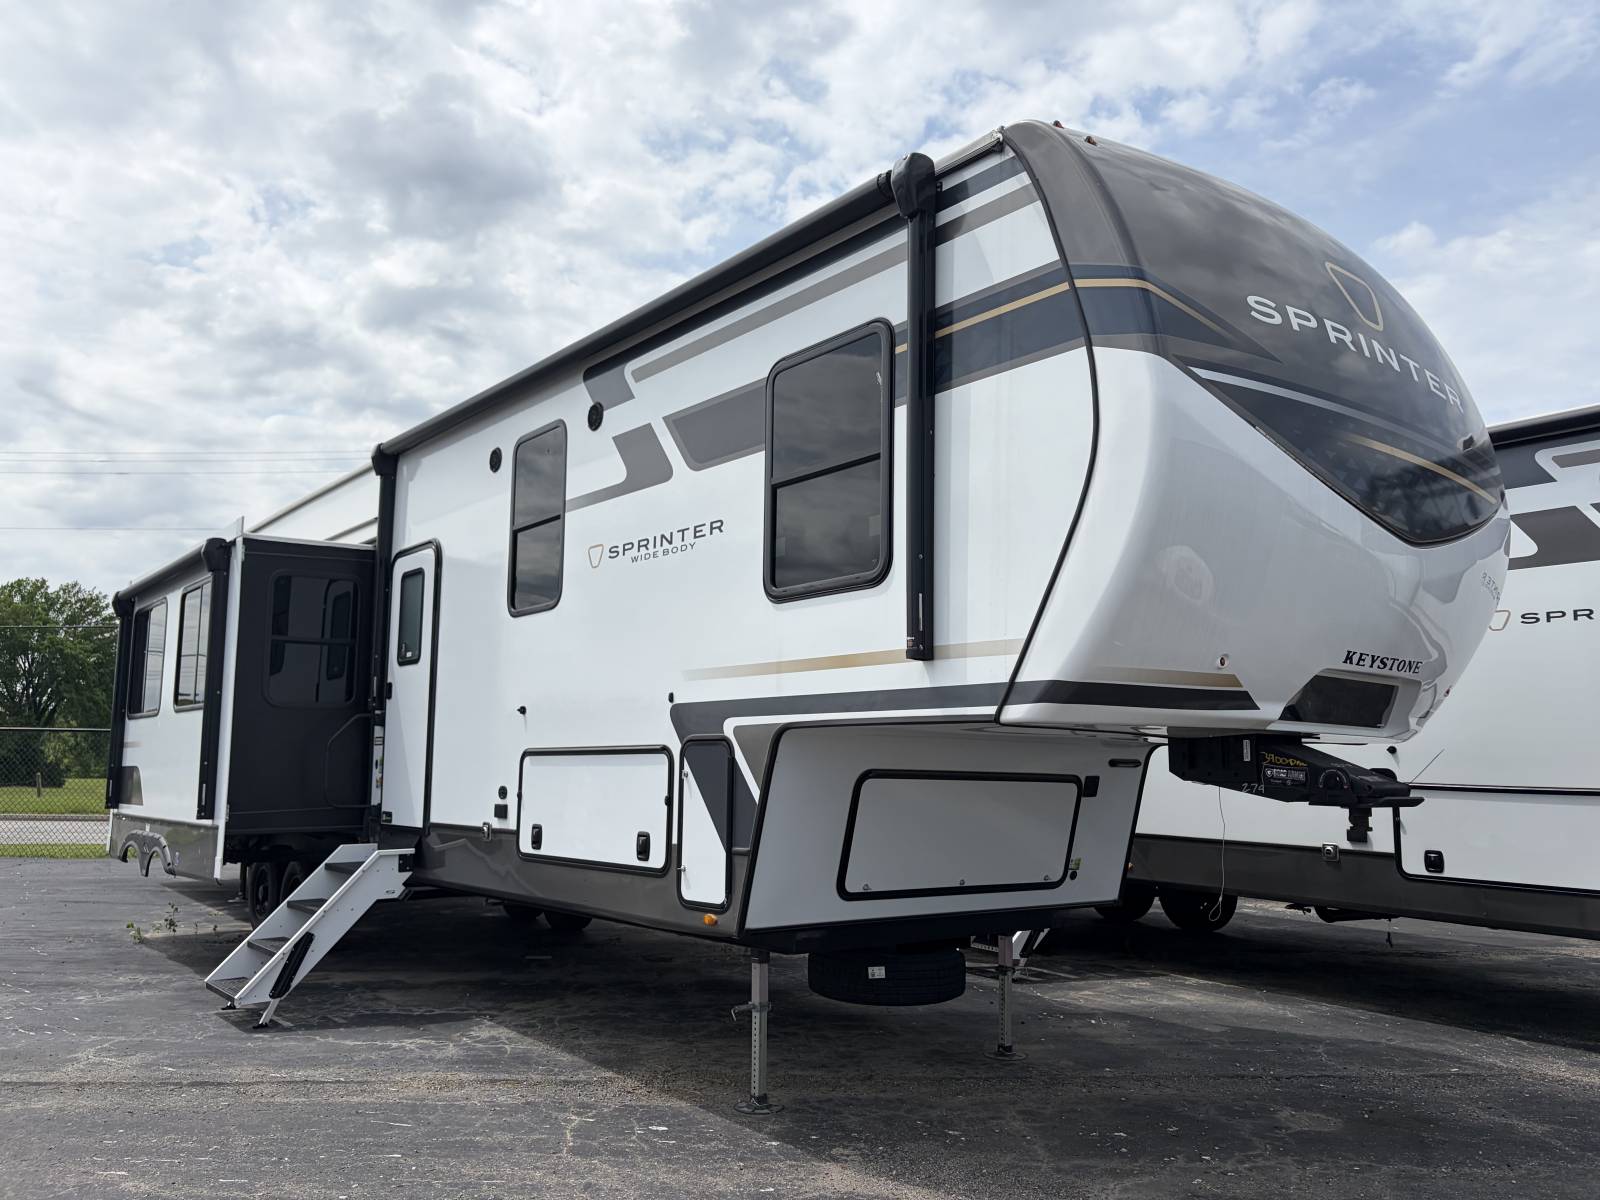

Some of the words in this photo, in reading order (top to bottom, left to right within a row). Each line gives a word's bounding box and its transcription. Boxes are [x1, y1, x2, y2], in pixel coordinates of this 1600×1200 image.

[1247, 295, 1464, 414] SPRINTER
[608, 519, 724, 559] SPRINTER
[1520, 608, 1594, 624] SPR
[1342, 650, 1423, 674] KEYSTONE
